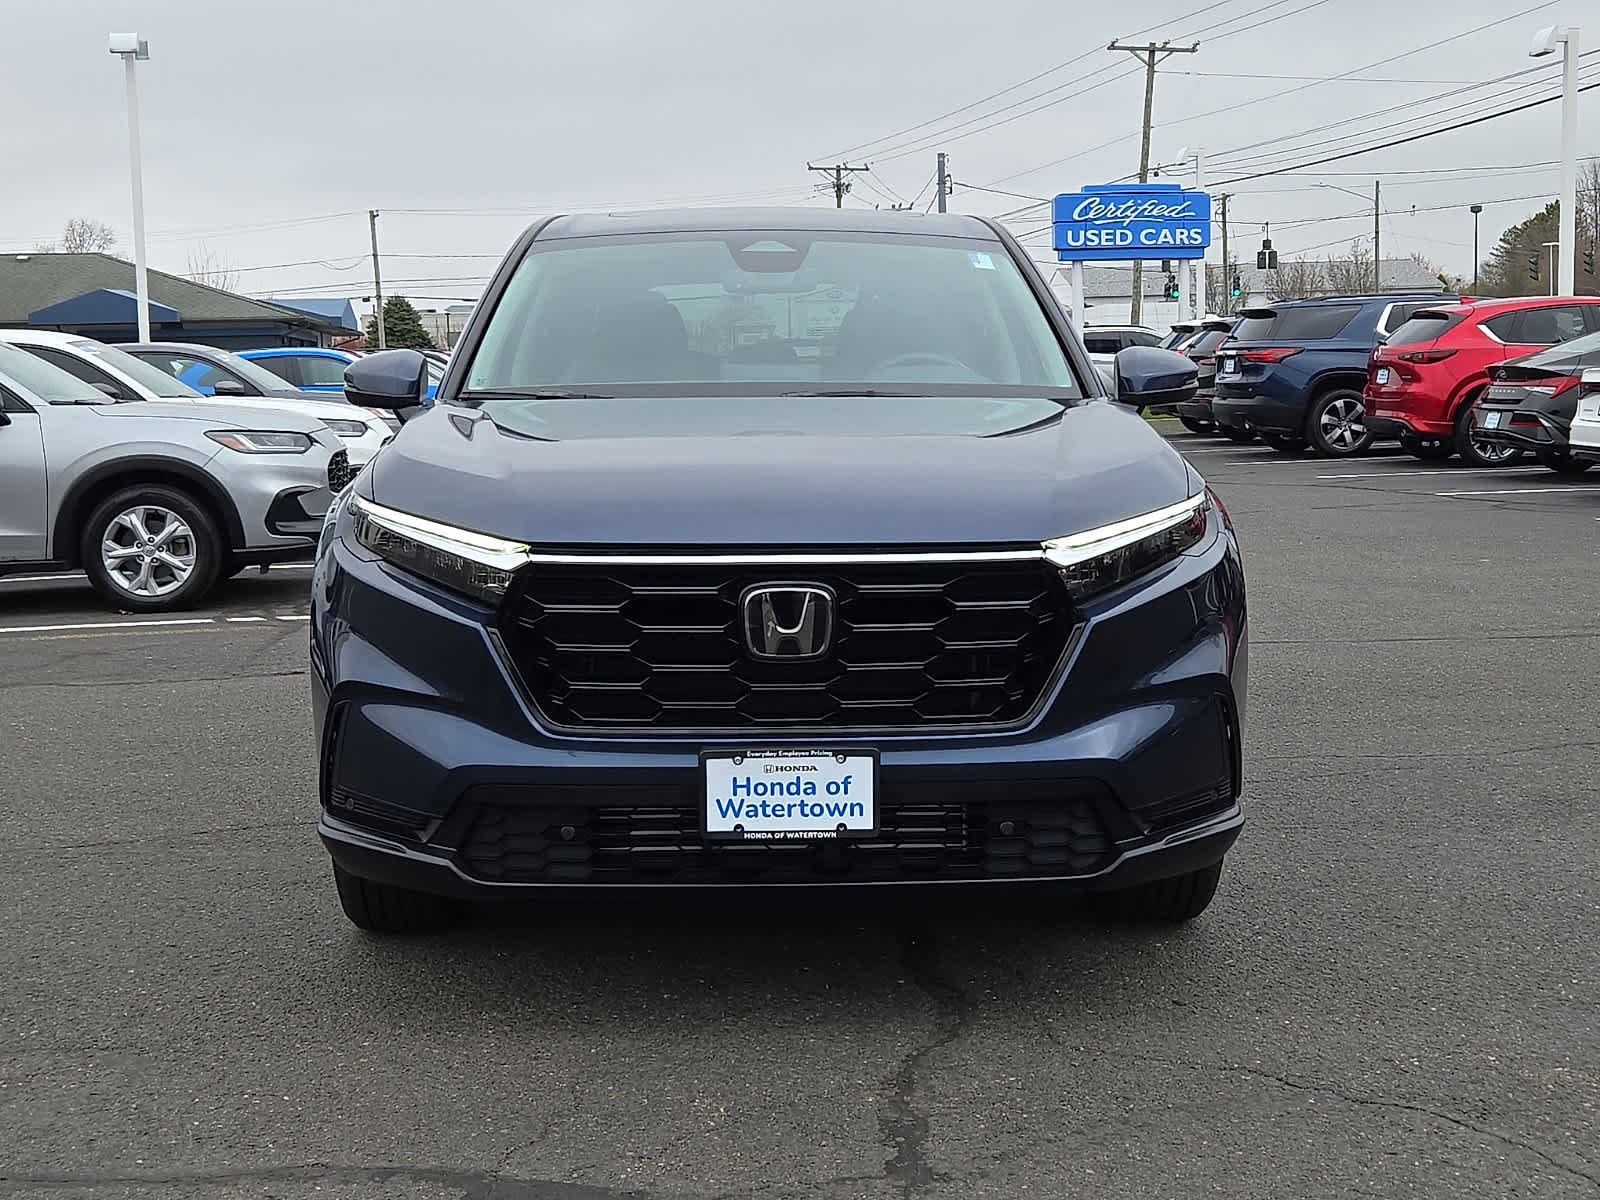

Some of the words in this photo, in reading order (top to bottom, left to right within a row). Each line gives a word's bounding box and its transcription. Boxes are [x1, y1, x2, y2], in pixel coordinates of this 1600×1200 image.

[1073, 197, 1196, 226] Certified
[1067, 230, 1133, 246] USED
[1139, 228, 1203, 245] CARS
[732, 775, 817, 796] Honda
[825, 775, 852, 796] of
[716, 798, 864, 818] Watertown
[786, 831, 837, 839] WATERTOWN
